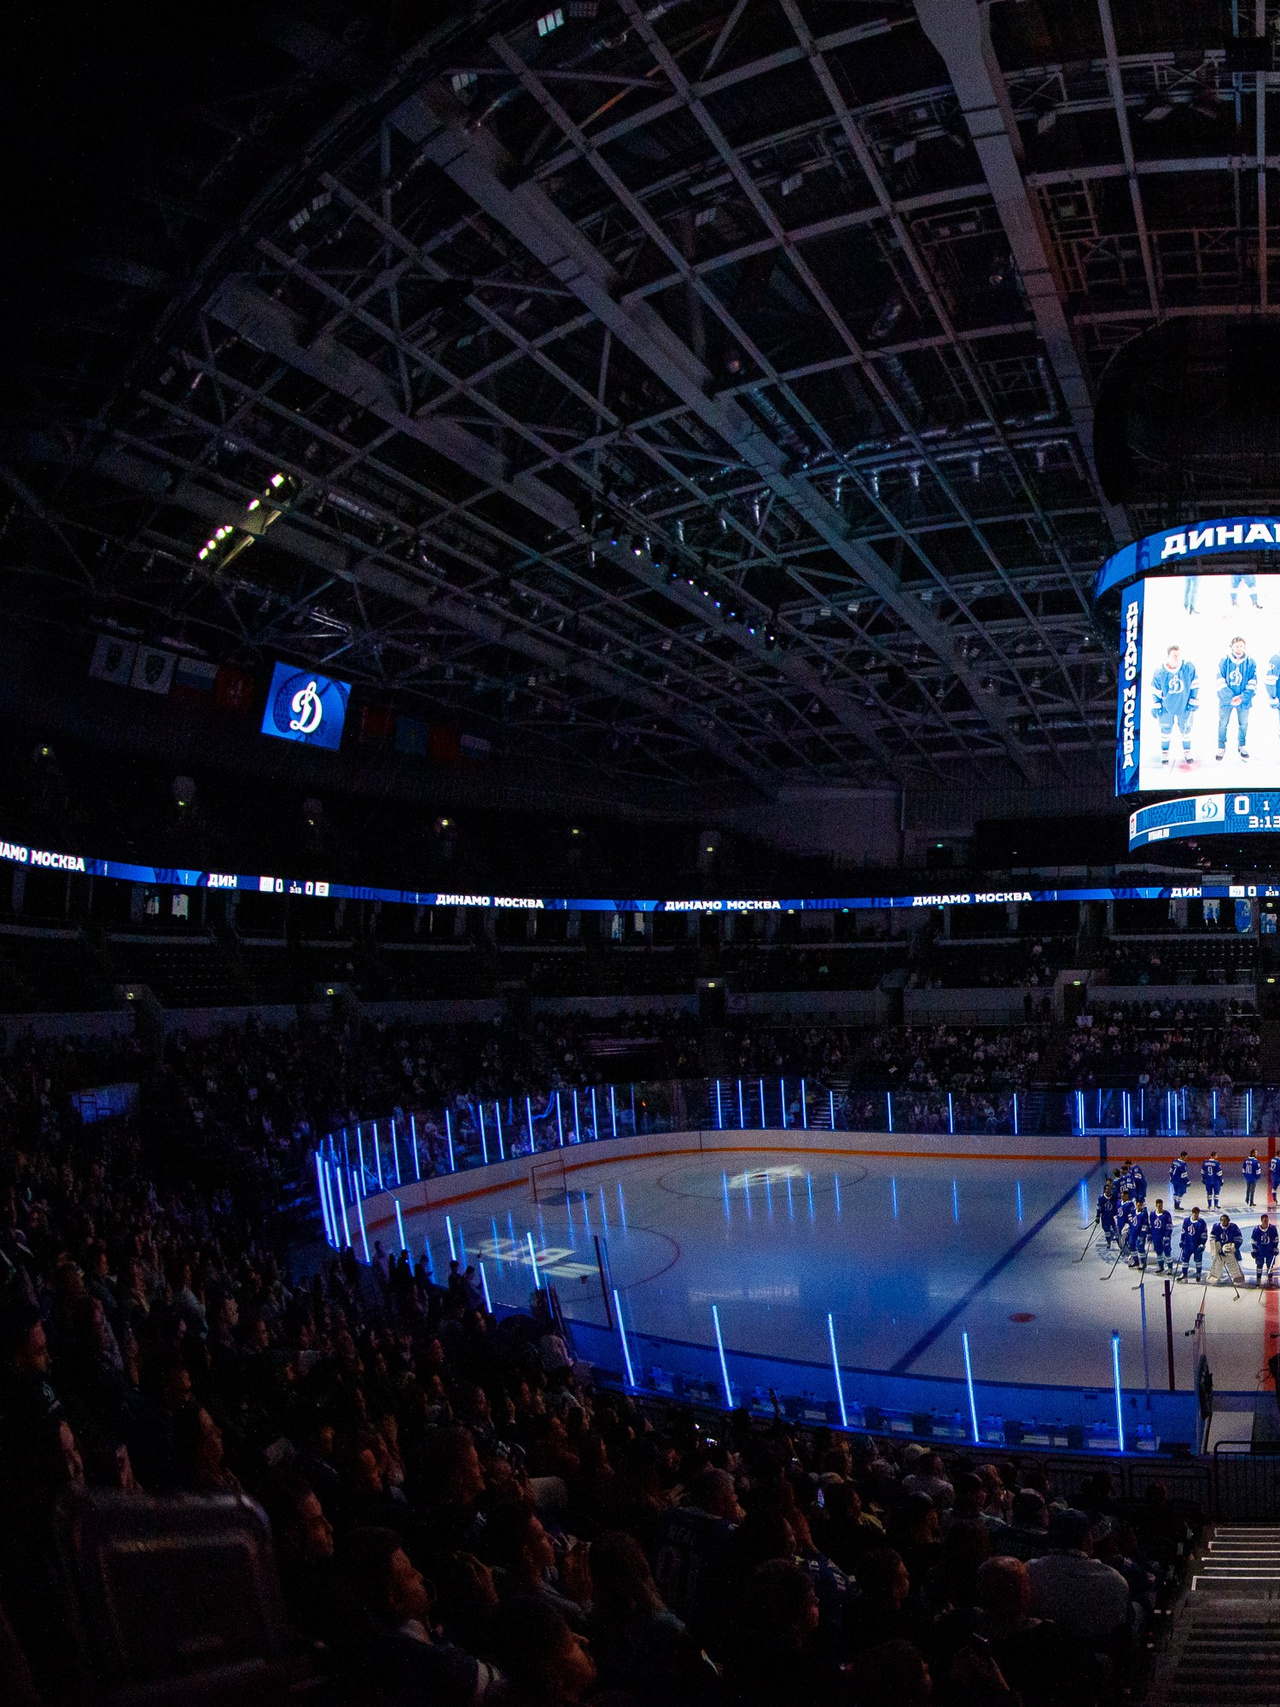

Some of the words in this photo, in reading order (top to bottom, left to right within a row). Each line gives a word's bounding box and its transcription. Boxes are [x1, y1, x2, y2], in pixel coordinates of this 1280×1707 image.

[1124, 601, 1139, 681] ДИНАМО
[1122, 685, 1137, 769] МОСКВА
[1234, 796, 1250, 815] 0
[1263, 801, 1270, 810] 1
[0, 842, 27, 862] АМО
[31, 850, 84, 871] МОСКВА
[207, 874, 236, 887] ДИН
[275, 879, 283, 892] 0
[305, 881, 313, 895] 0
[1171, 888, 1201, 898] ДИН
[1248, 886, 1256, 896] 0
[436, 894, 490, 906] ДИНАМО
[494, 897, 544, 908] МОСКВА
[665, 901, 722, 910] ДИНАМО
[727, 901, 781, 909] МОСКВА
[912, 894, 970, 906] ДИНАМО
[975, 892, 1032, 902] МОСКВА
